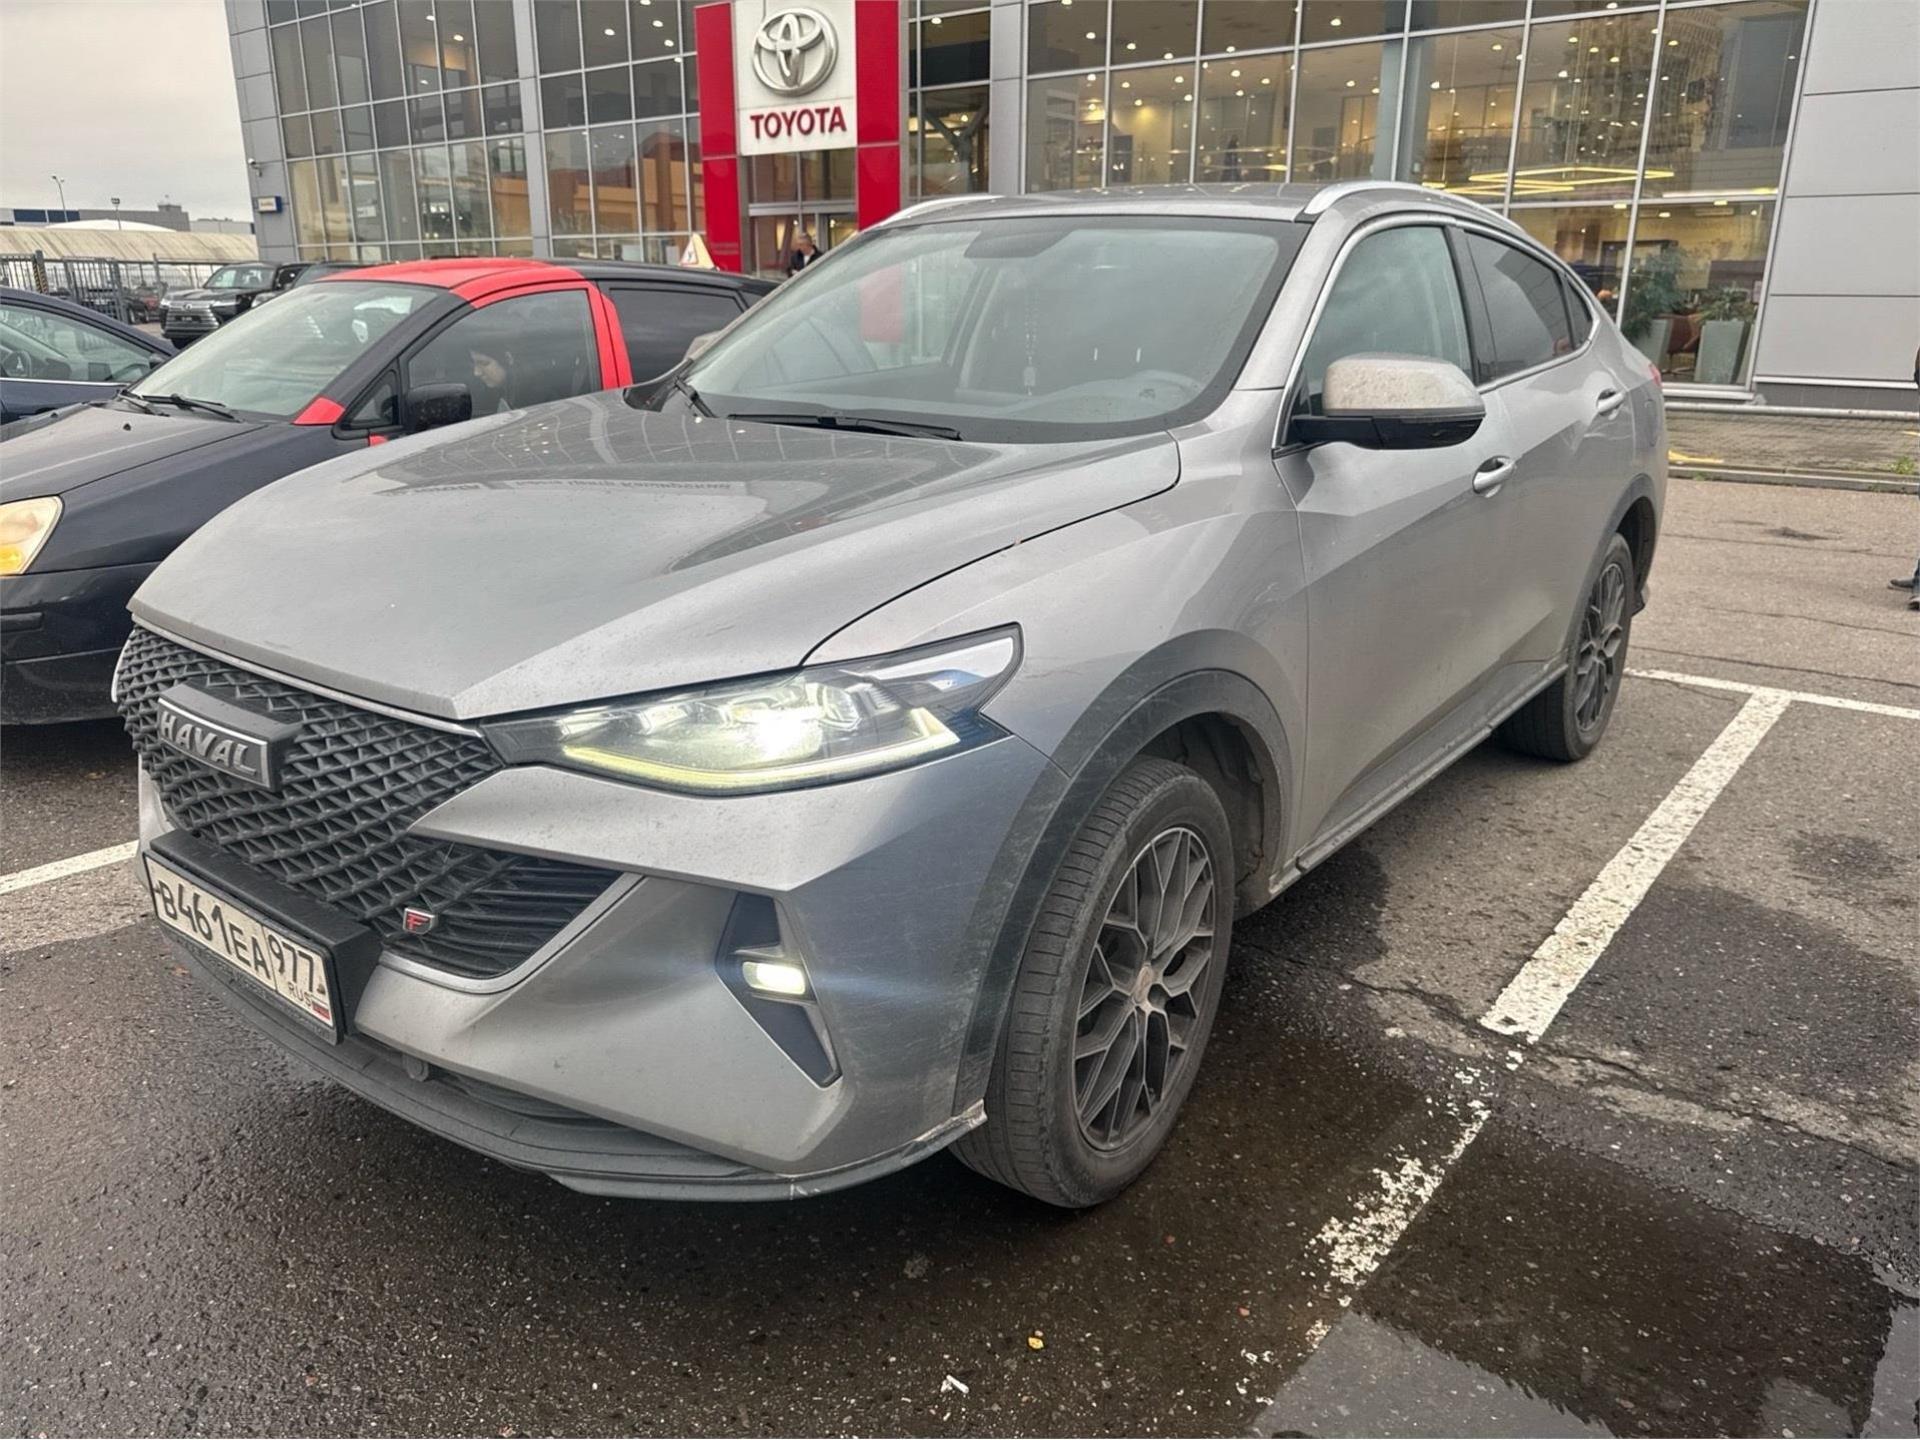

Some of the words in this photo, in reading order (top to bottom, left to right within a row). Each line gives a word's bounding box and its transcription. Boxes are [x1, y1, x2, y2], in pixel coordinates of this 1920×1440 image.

[749, 106, 847, 140] TOYOTA
[160, 710, 257, 776] HAVAL
[407, 911, 430, 931] F
[268, 933, 315, 993] 977
[287, 981, 312, 1008] RUS
